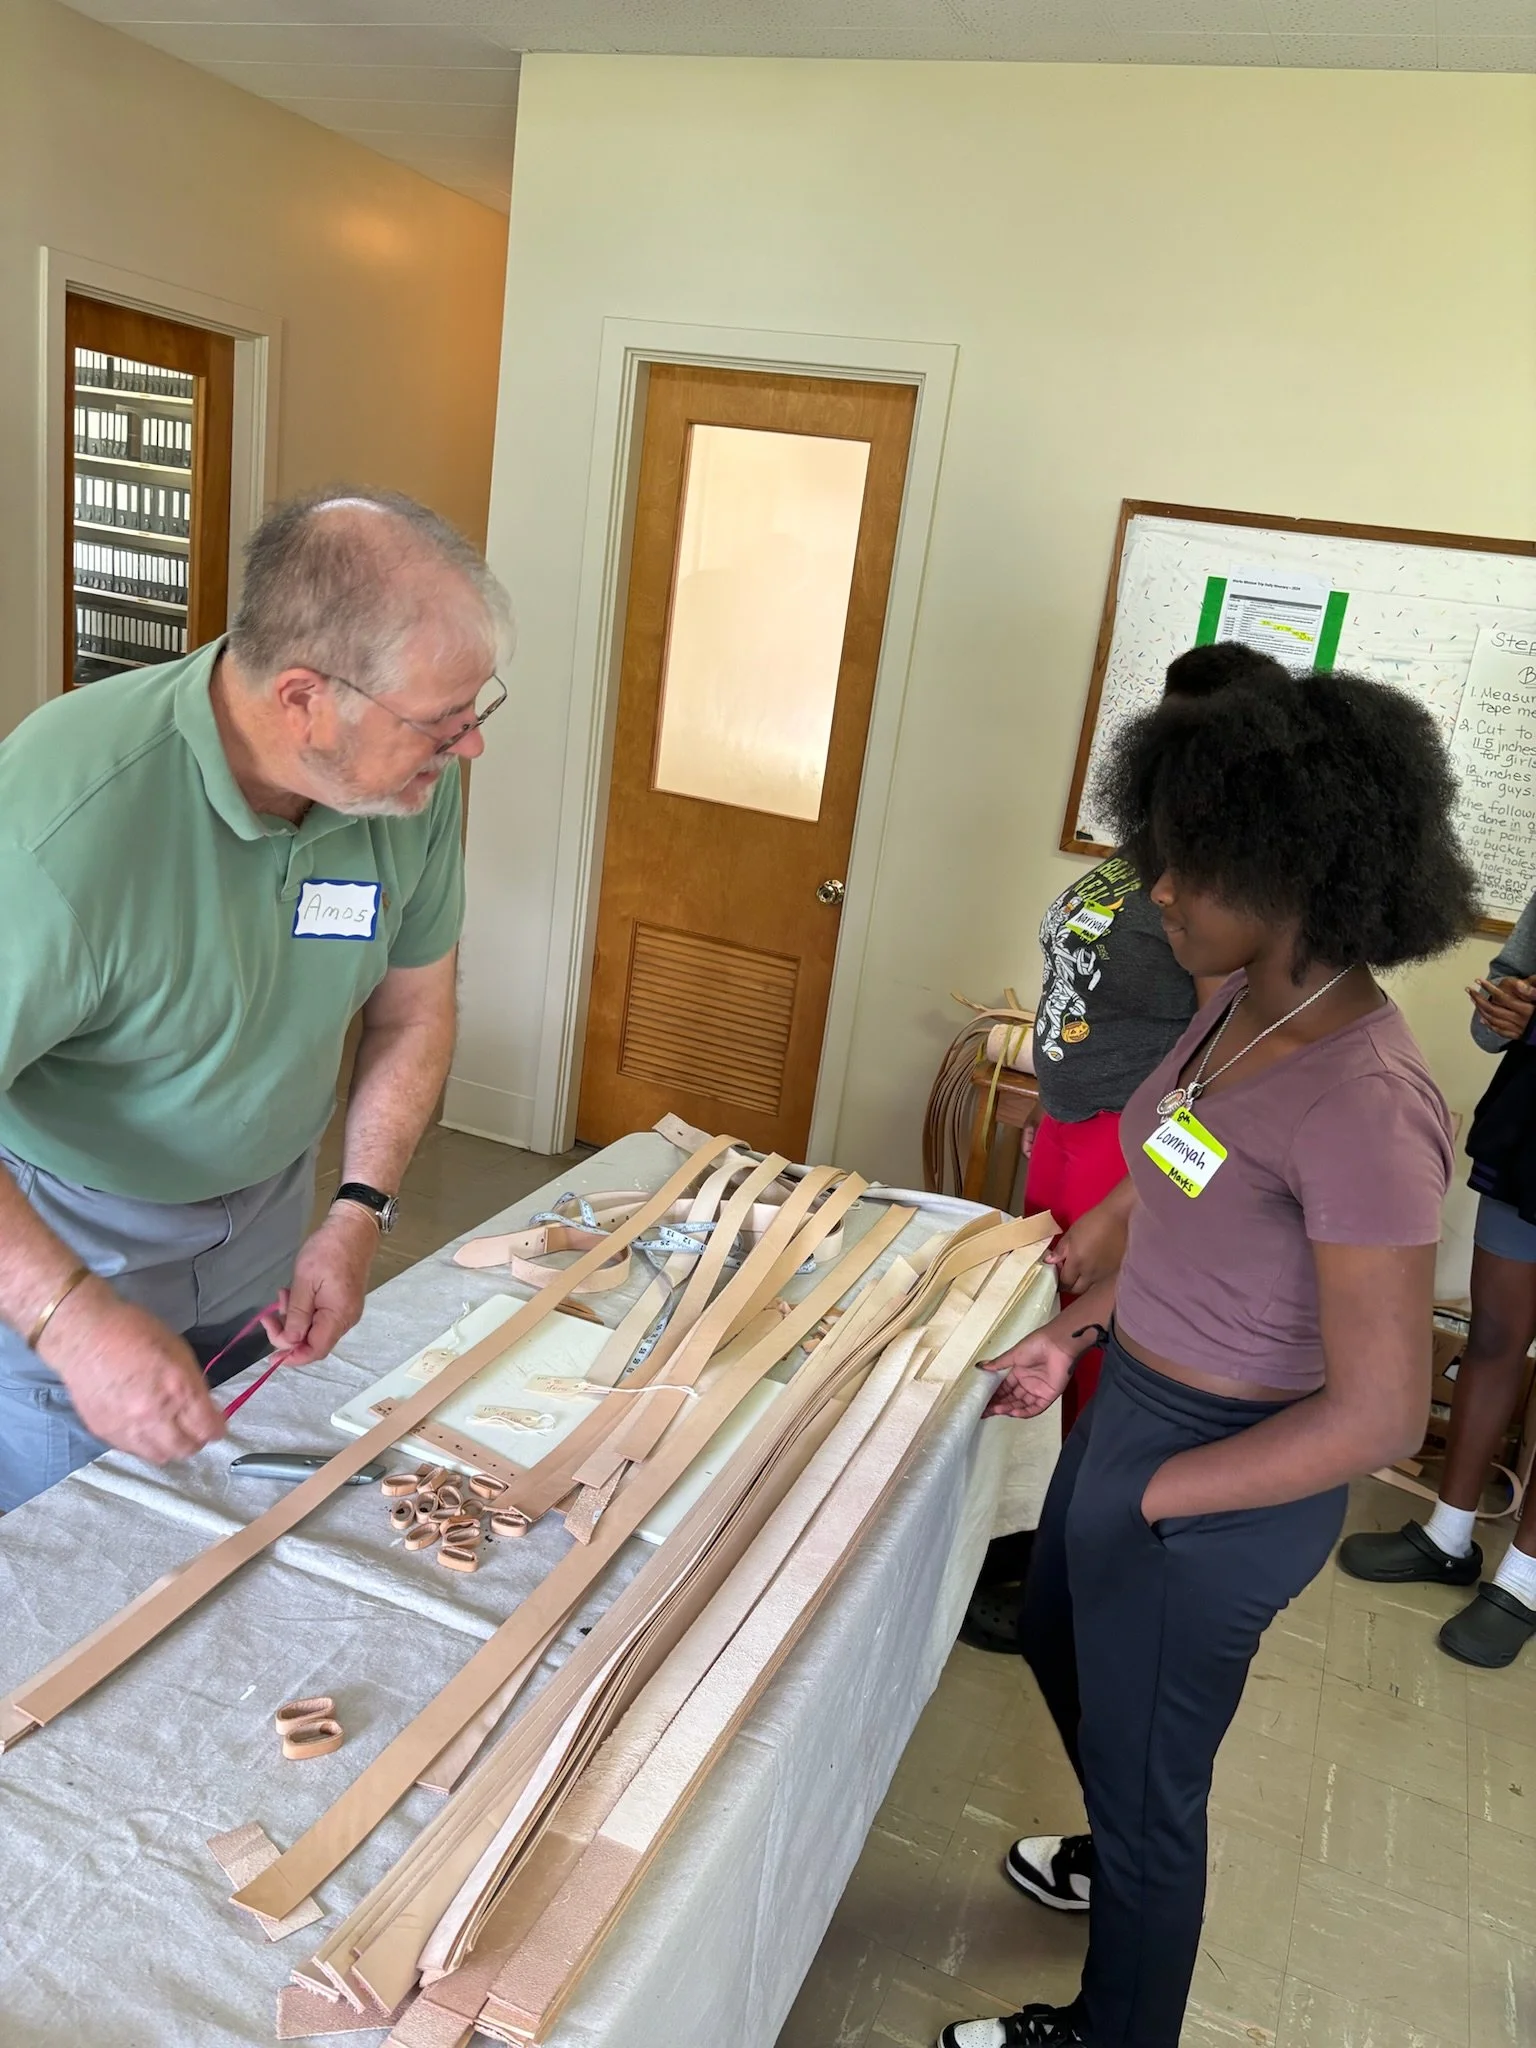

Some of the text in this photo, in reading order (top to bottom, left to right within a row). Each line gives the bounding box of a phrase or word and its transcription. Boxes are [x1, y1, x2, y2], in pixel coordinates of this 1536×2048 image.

[1477, 701, 1511, 716] tape
[1477, 719, 1506, 735] Cut
[1515, 725, 1533, 739] to
[1480, 749, 1500, 760] for
[1466, 764, 1531, 782] 12 inches
[1472, 775, 1492, 788] for
[1478, 811, 1507, 827] done
[1510, 818, 1520, 829] in
[1472, 825, 1495, 836] cut
[1466, 836, 1479, 847] do
[1484, 838, 1526, 858] buckle
[1480, 860, 1512, 876] holes
[1502, 854, 1536, 870] holes
[1505, 878, 1528, 890] end
[303, 893, 369, 923] Amos
[1168, 1167, 1194, 1192] Marks
